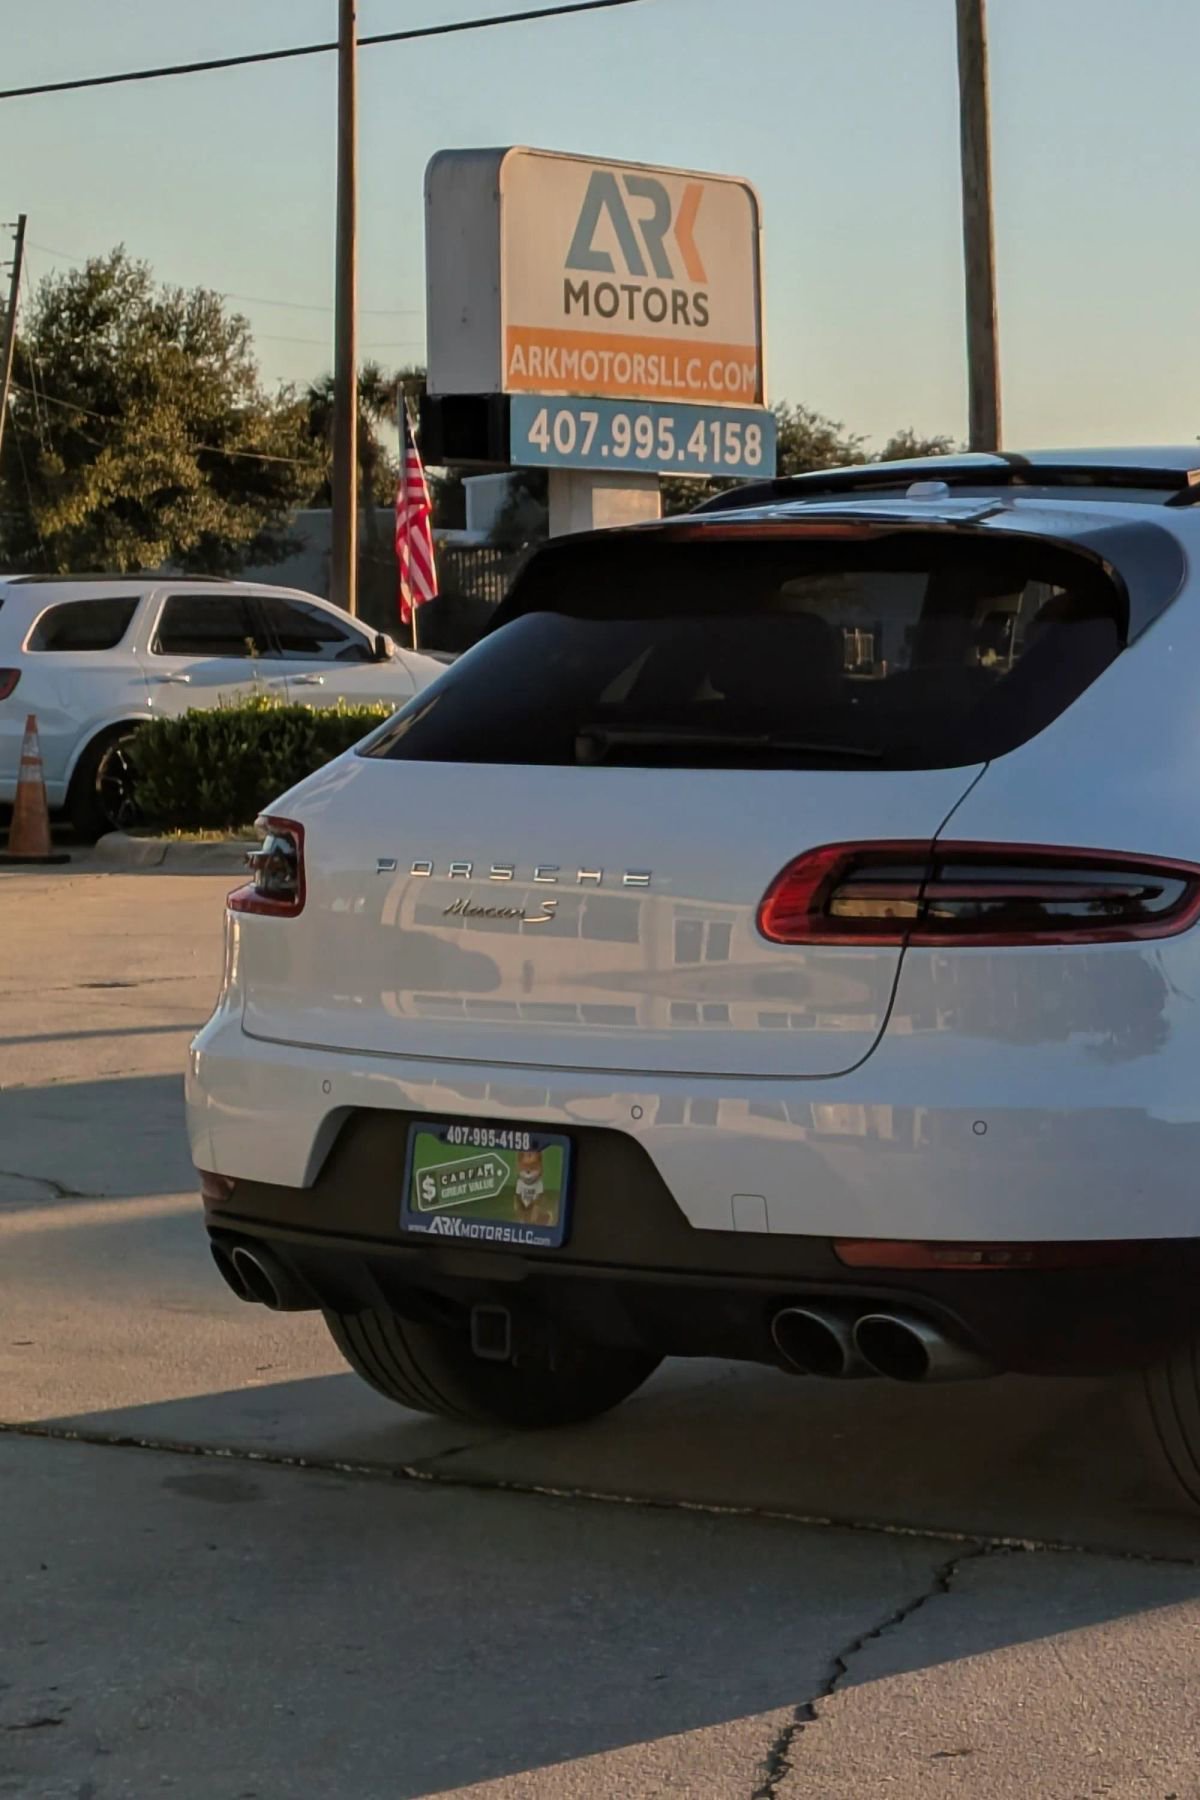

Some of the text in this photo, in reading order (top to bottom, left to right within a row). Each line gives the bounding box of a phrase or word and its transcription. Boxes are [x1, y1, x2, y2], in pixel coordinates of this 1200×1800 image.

[564, 170, 708, 284] ARK
[564, 278, 709, 327] MOTORS
[509, 345, 757, 393] ARKMOTORSLLC.COM
[528, 408, 762, 466] 407.995.4158
[376, 858, 651, 887] PORSCHE
[443, 898, 559, 923] Macan S
[446, 1125, 530, 1150] 407-995-4158
